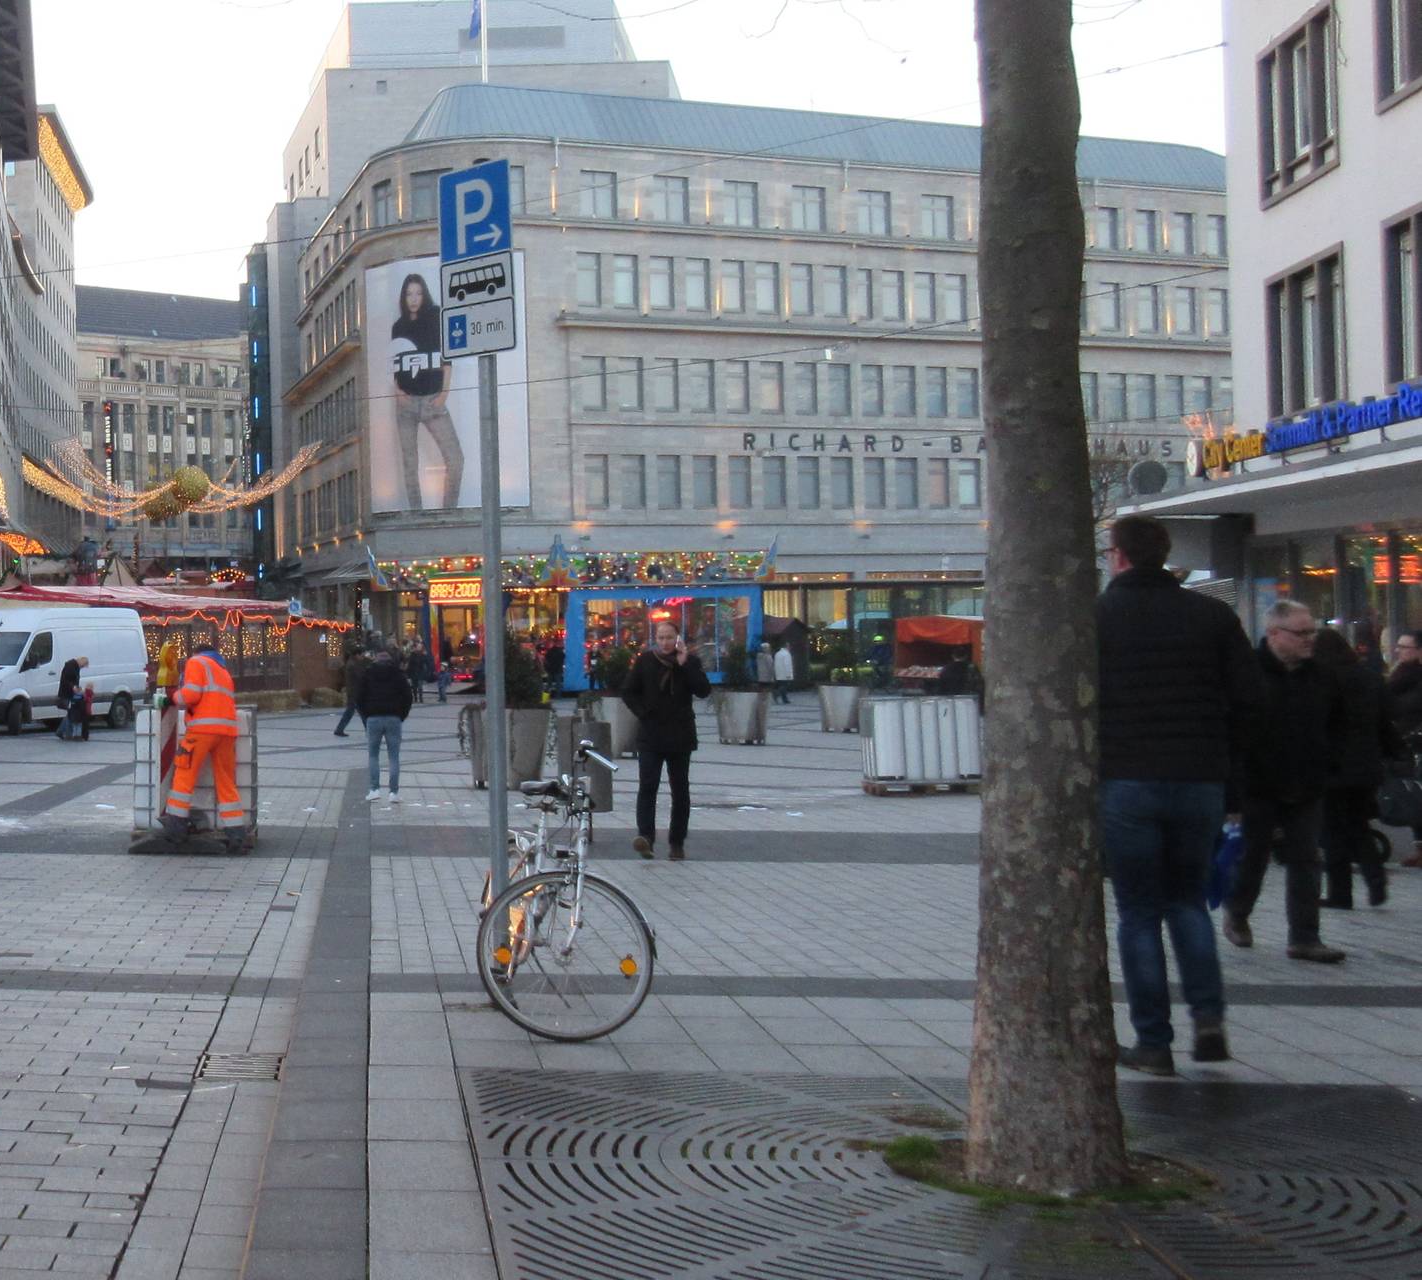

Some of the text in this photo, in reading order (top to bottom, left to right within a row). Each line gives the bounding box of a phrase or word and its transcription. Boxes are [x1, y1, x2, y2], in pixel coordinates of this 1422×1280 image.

[456, 179, 493, 255] P
[470, 321, 482, 335] 30
[1321, 404, 1333, 438] &
[1336, 399, 1393, 433] Partner
[1398, 383, 1422, 418] Re
[430, 583, 480, 598] BABY 2000
